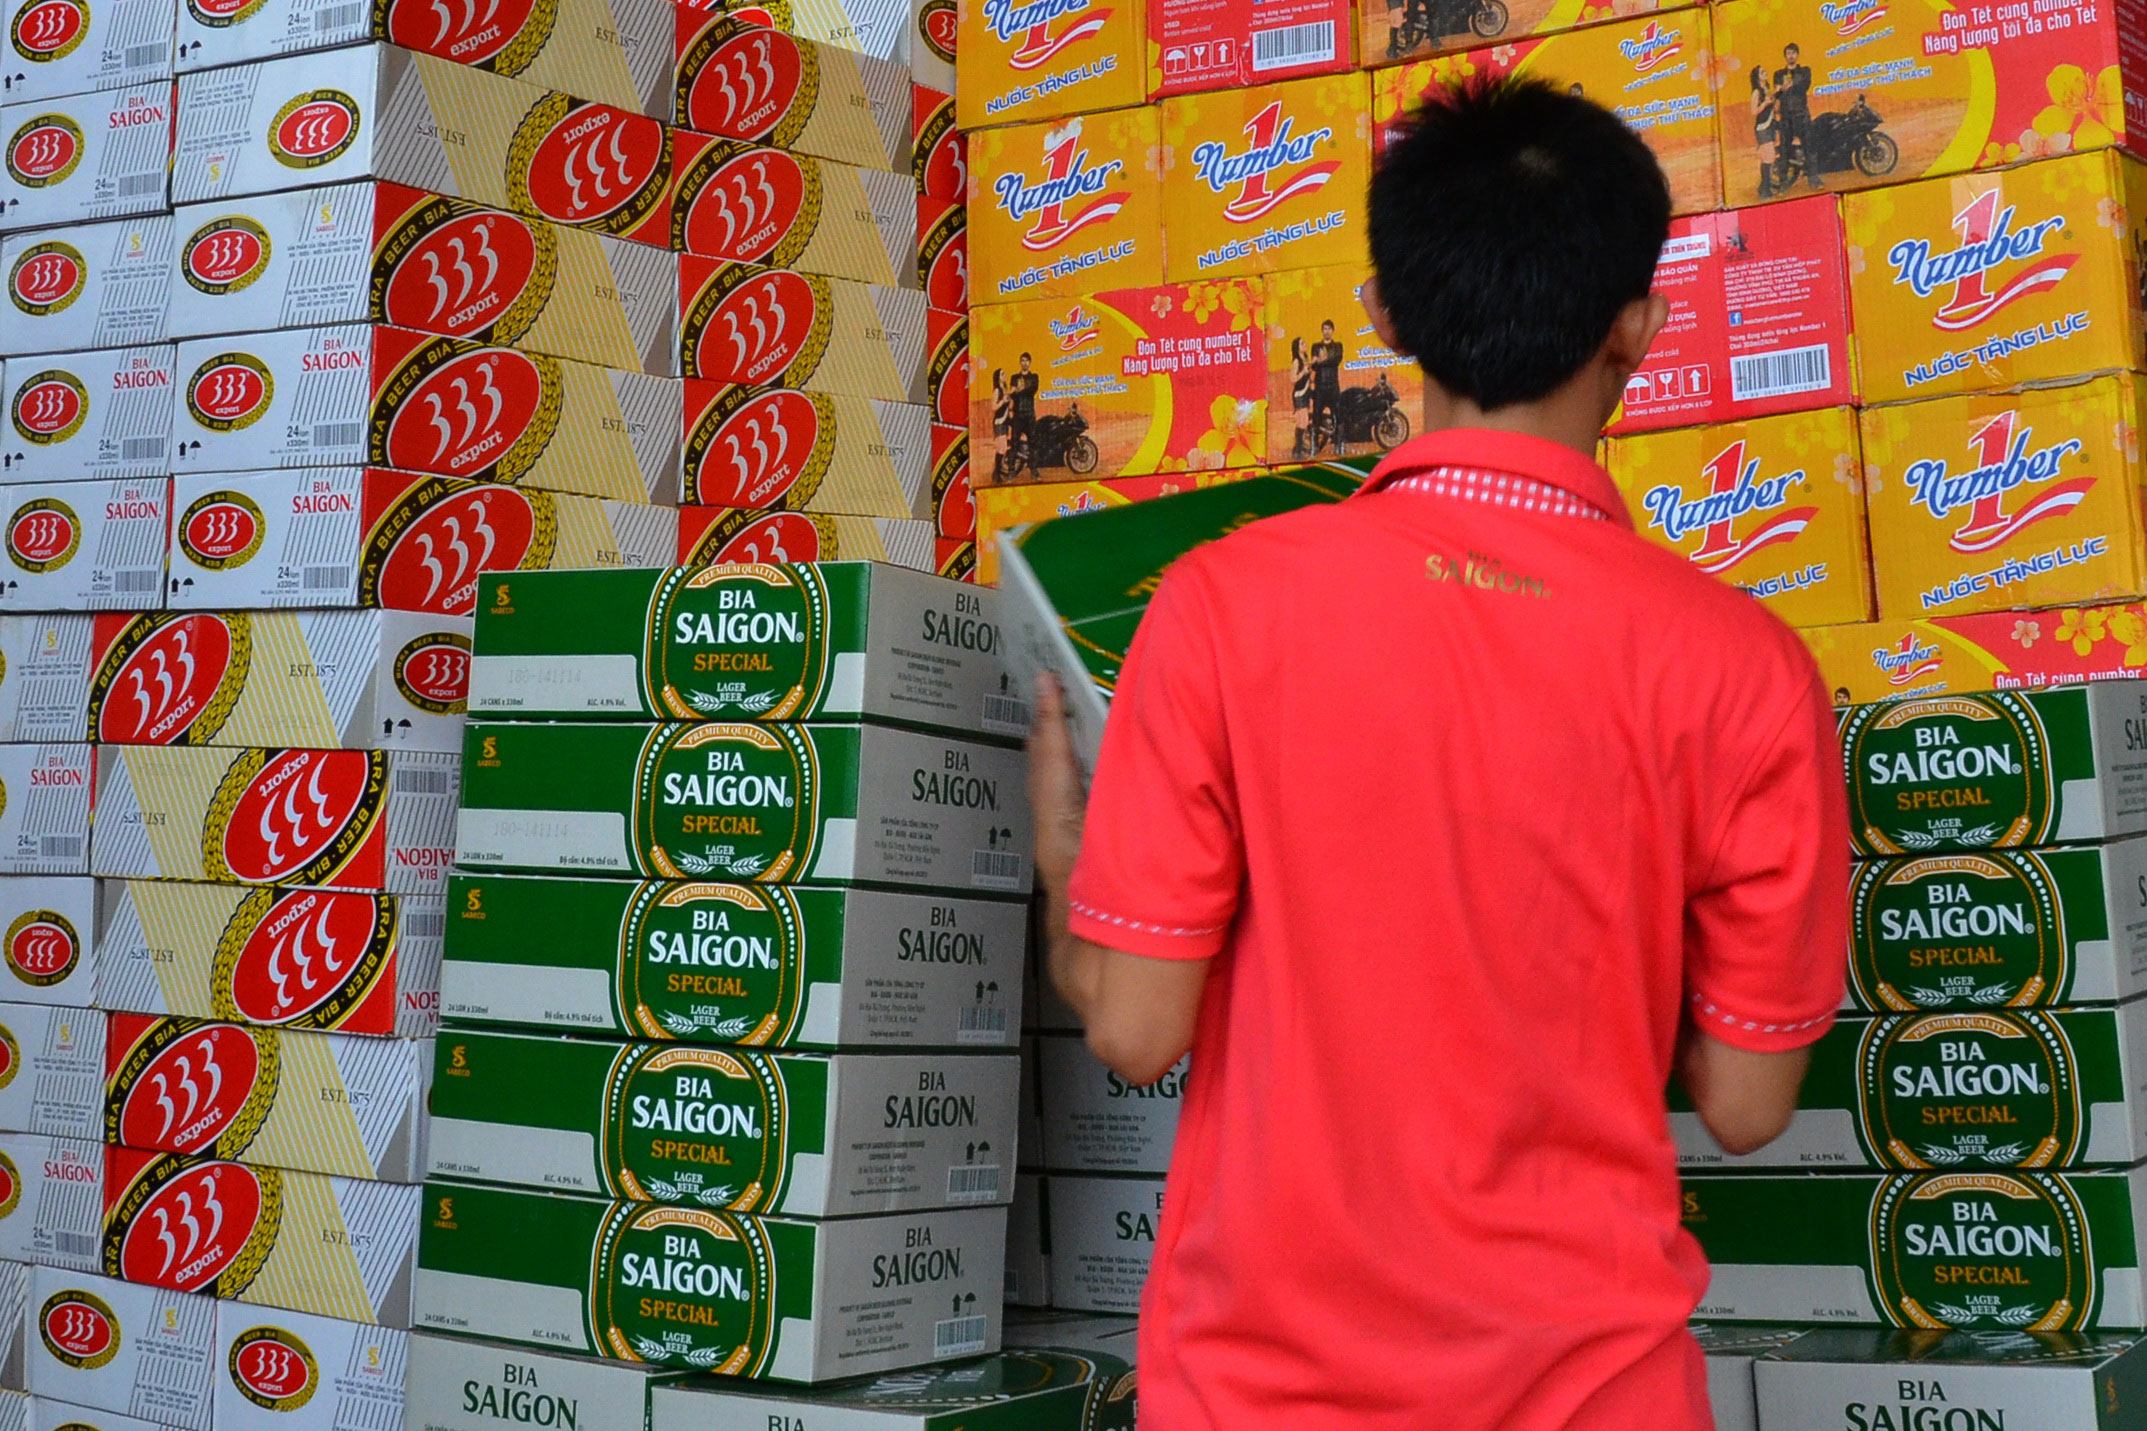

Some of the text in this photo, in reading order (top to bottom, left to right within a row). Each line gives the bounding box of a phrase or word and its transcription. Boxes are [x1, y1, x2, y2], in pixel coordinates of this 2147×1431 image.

[2048, 11, 2071, 30] cho
[715, 40, 774, 128] 333
[128, 97, 145, 108] BIA
[109, 107, 164, 129] SAIGON
[422, 224, 498, 323] 333
[324, 339, 341, 351] BIA
[1205, 333, 1243, 348] number
[1246, 330, 1251, 344] 1
[1975, 331, 2038, 365] TĂNG
[2038, 311, 2090, 340] LỰC
[302, 351, 362, 372] SAIGON
[1214, 349, 1231, 364] cho
[725, 404, 788, 500] 333
[313, 481, 331, 493] BIA
[292, 493, 351, 514] SAIGON
[1990, 558, 2054, 587] TĂNG
[2056, 536, 2108, 565] LỰC
[699, 565, 780, 584] PREMIUM QUALITY
[719, 590, 756, 609] BIA
[955, 593, 981, 616] BIA
[675, 613, 798, 643] SAIGON
[694, 653, 773, 671] SPECIAL
[128, 630, 195, 738] 333
[716, 682, 746, 693] LAGER
[720, 692, 742, 702] BEER
[1889, 701, 1983, 725] PREMIUM QUALITY
[1915, 726, 1960, 747] BIA
[49, 755, 65, 767] BIA
[707, 752, 745, 771] BIA
[944, 750, 970, 772] BIA
[1868, 744, 2011, 784] SAIGON
[31, 768, 82, 787] SAIGON
[664, 774, 786, 807] SAIGON
[912, 769, 997, 811] SAIGON
[1897, 788, 1991, 811] SPECIAL
[682, 815, 762, 835] SPECIAL
[1927, 818, 1962, 829] LAGER
[1933, 828, 1959, 838] BEER
[1927, 883, 1972, 904] BIA
[692, 911, 729, 931] BIA
[930, 907, 956, 927] BIA
[1881, 903, 2024, 940] SAIGON
[649, 931, 770, 969] SAIGON
[898, 928, 983, 965] SAIGON
[1909, 948, 2003, 967] SPECIAL
[667, 973, 748, 997] SPECIAL
[1914, 1017, 2009, 1038] PREMIUM QUALITY
[1940, 1042, 1985, 1062] BIA
[152, 1038, 222, 1144] 333
[675, 1077, 713, 1099] BIA
[918, 1072, 945, 1091] BIA
[1892, 1063, 2038, 1098] SAIGON
[631, 1096, 755, 1138] SAIGON
[884, 1095, 975, 1129] SAIGON
[1922, 1106, 2018, 1125] SPECIAL
[650, 1139, 731, 1165] SPECIAL
[1953, 1202, 1998, 1222] BIA
[664, 1235, 701, 1259] BIA
[906, 1227, 932, 1249] BIA
[1905, 1224, 2051, 1257] SAIGON
[621, 1253, 743, 1301] SAIGON
[872, 1247, 960, 1288] SAIGON
[1934, 1266, 2030, 1285] SPECIAL
[1965, 1295, 2001, 1306] LAGER
[1970, 1305, 1998, 1316] BEER
[639, 1299, 718, 1326] SPECIAL
[503, 1364, 538, 1387] BIA
[1898, 1380, 1946, 1402] BIA
[462, 1380, 578, 1431] SAIGON
